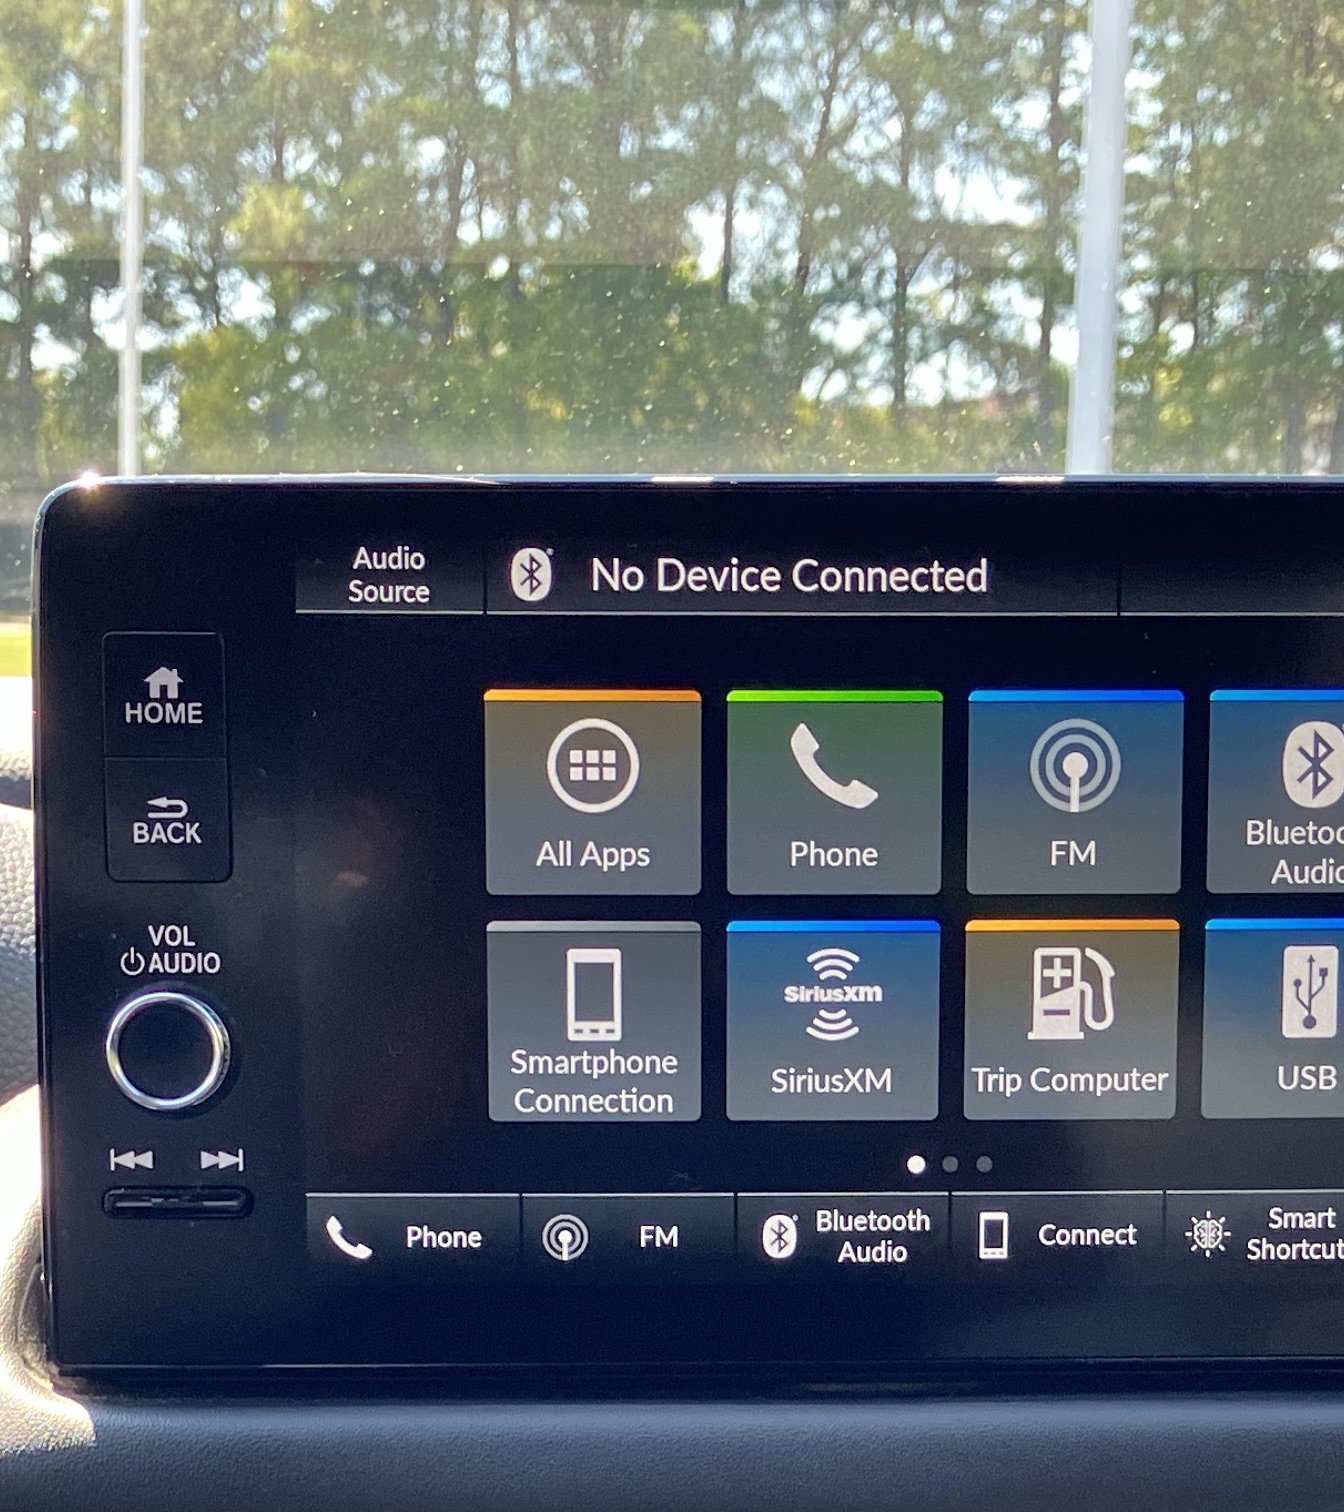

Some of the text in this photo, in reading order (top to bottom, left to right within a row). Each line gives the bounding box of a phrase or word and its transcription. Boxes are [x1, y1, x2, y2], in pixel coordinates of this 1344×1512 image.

[353, 546, 425, 569] Audio
[593, 558, 988, 593] No Device Connected
[349, 580, 429, 602] Source
[123, 701, 204, 725] HOME
[131, 821, 203, 845] BACK
[536, 841, 650, 871] All Apps
[788, 840, 879, 868] Phone
[1052, 841, 1095, 865] FM
[148, 925, 195, 946] VOL
[148, 951, 221, 974] AUDIO
[511, 1048, 677, 1079] Smartphone
[772, 1068, 891, 1093] SiriusXM
[971, 1067, 1169, 1096] Trip Computer
[1279, 1066, 1337, 1089] USB
[515, 1087, 673, 1112] Connection
[817, 1208, 930, 1231] Bluetooth
[1269, 1208, 1336, 1228] Smart
[407, 1226, 482, 1248] Phone
[641, 1226, 678, 1247] FM
[1039, 1224, 1137, 1245] Connect
[838, 1240, 907, 1262] Audio
